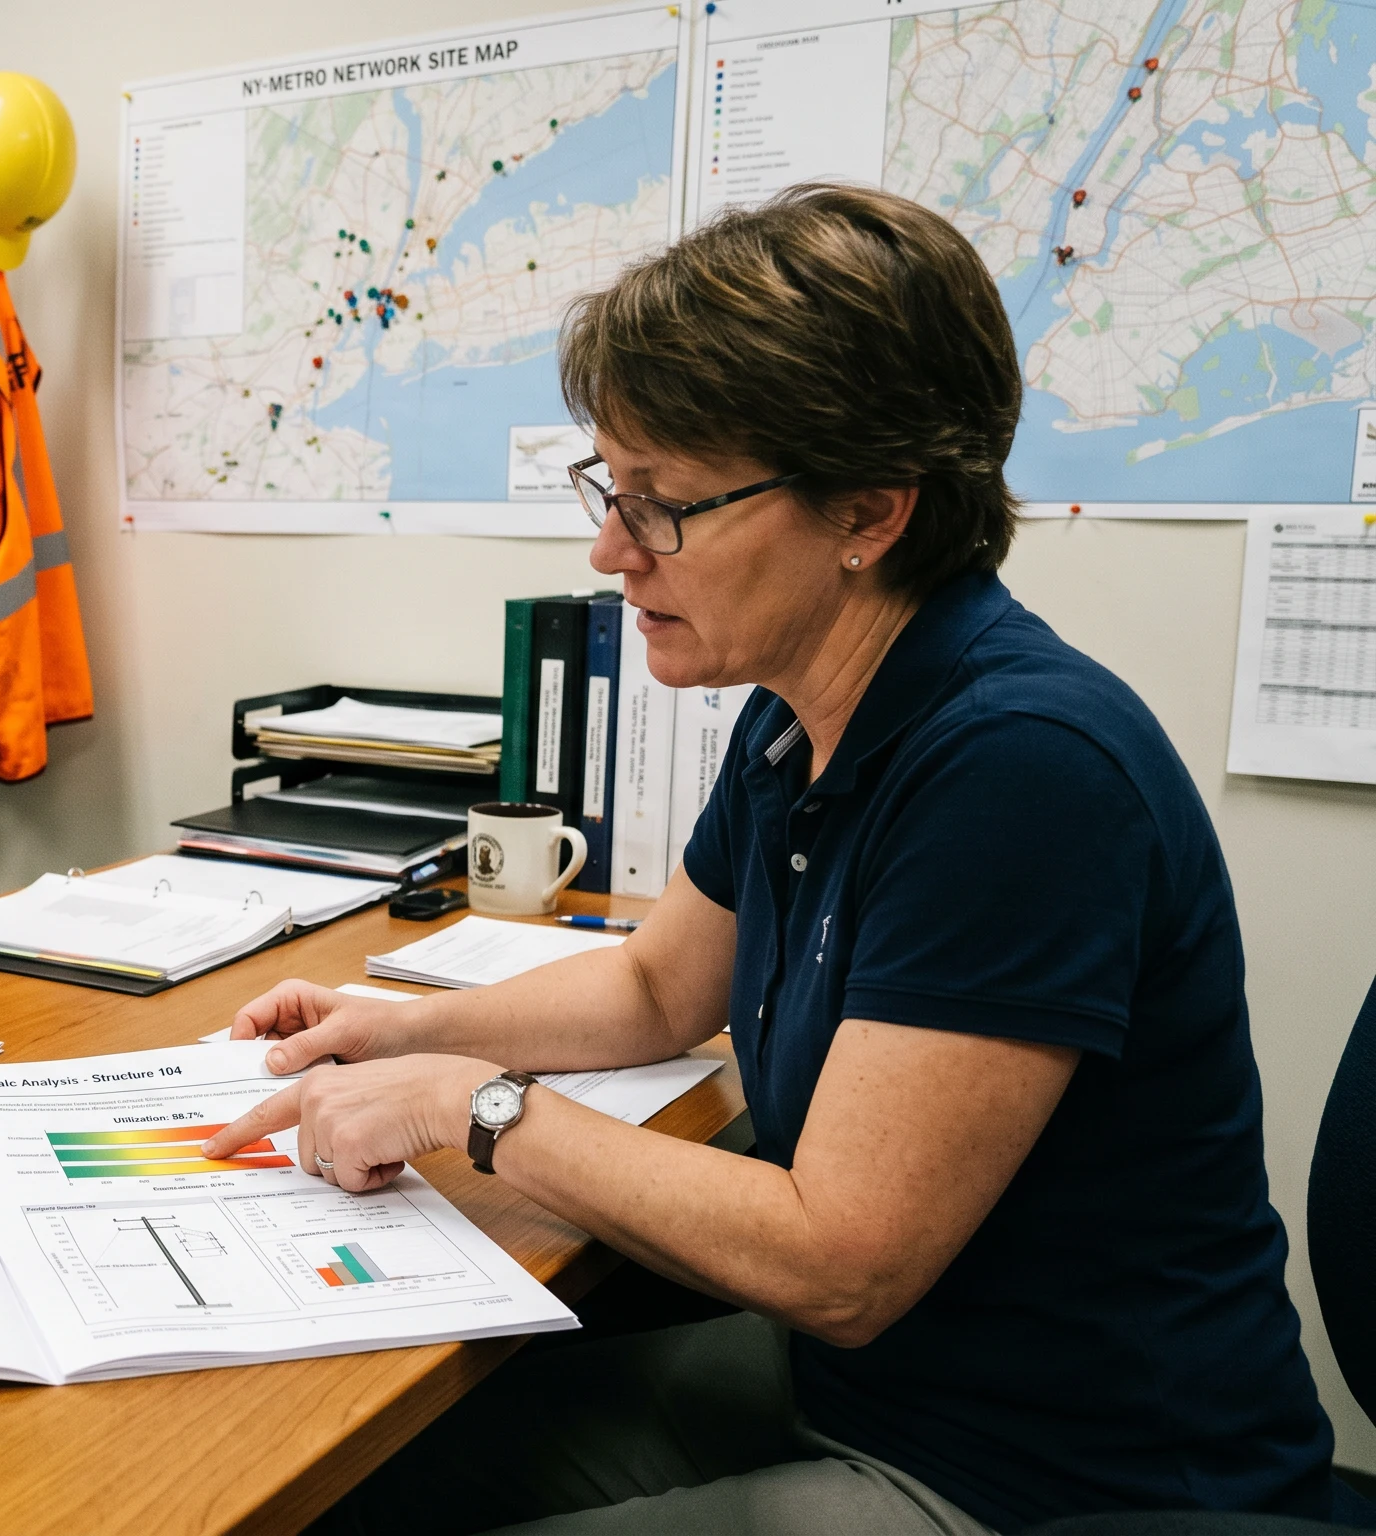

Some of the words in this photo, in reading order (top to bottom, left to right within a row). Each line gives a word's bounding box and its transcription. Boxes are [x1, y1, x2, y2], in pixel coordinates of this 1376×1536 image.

[242, 68, 328, 97] NY-METRO
[333, 54, 421, 83] NETWORK
[428, 47, 468, 70] SITE
[475, 40, 519, 63] MAP
[21, 1076, 79, 1090] Analysis
[91, 1070, 154, 1083] Structure
[158, 1066, 183, 1077] 104
